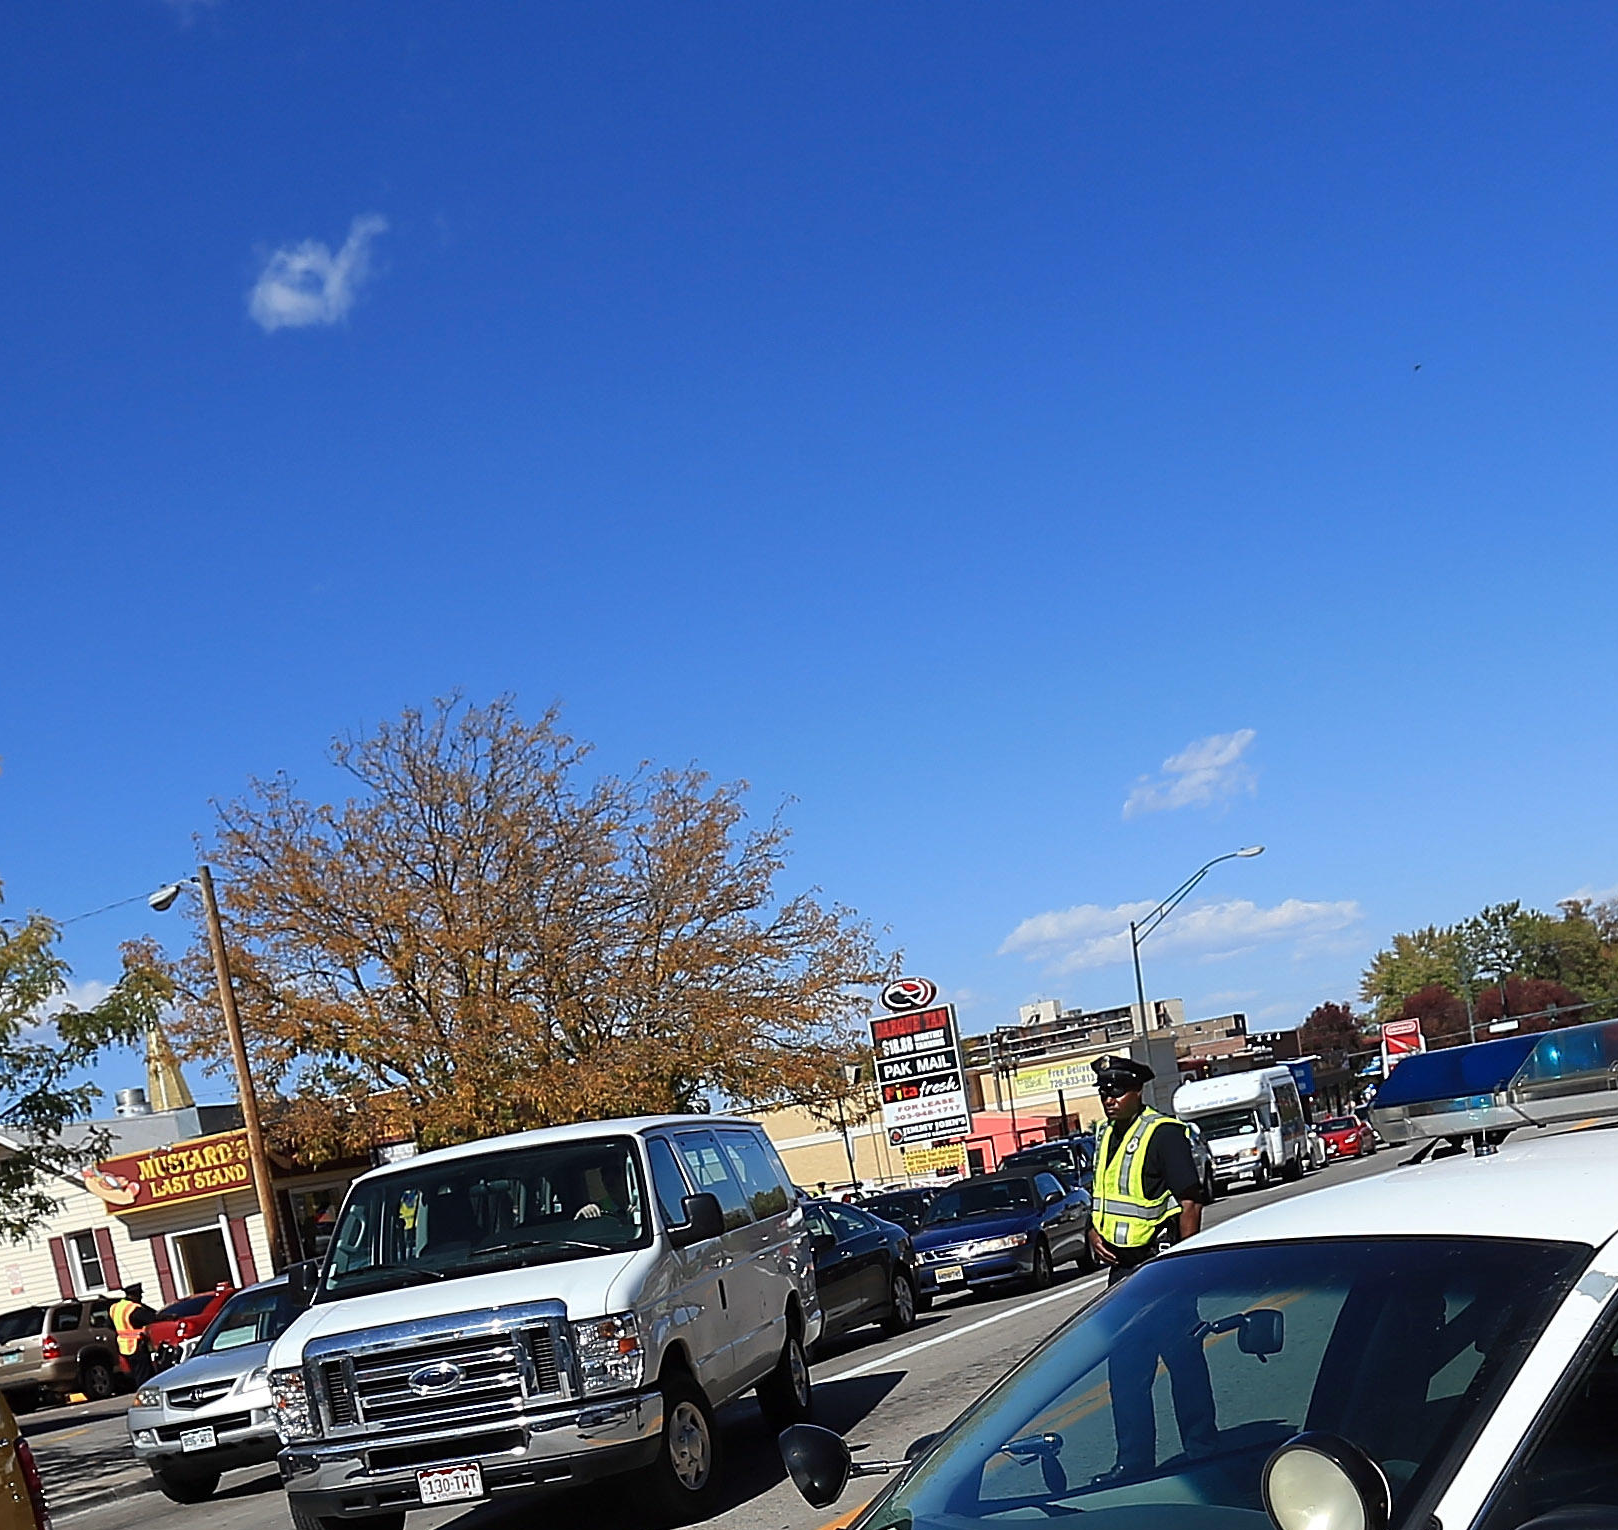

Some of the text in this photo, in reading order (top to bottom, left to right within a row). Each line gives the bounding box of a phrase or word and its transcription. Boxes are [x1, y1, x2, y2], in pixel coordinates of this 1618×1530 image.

[883, 1054, 951, 1079] PAK MAIL
[1048, 1068, 1064, 1078] Free
[898, 1097, 955, 1112] FOR LEASE
[903, 1122, 934, 1136] JIMMY
[137, 1139, 250, 1181] MUSTARD'S
[149, 1163, 247, 1198] LAST STAND
